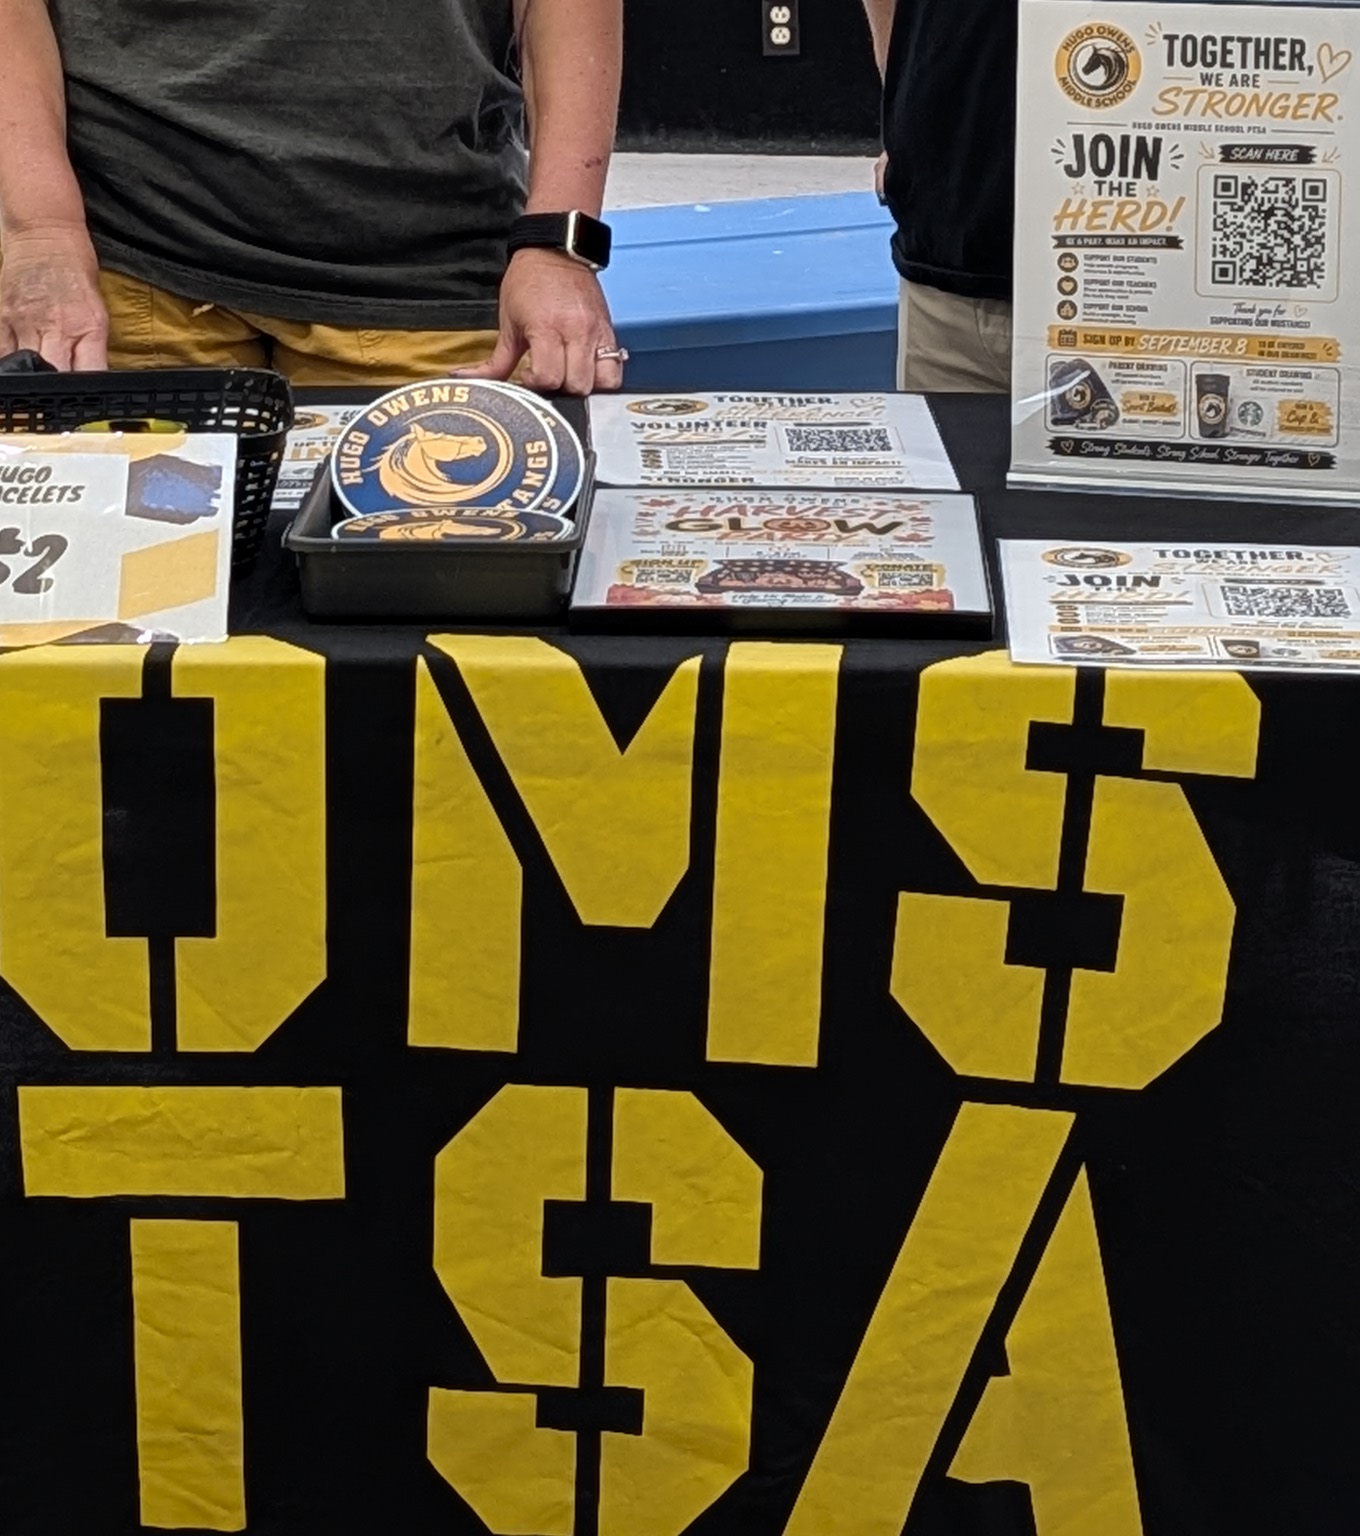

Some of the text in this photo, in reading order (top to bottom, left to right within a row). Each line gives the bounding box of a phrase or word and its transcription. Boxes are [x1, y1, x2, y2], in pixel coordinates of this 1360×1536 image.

[1062, 25, 1135, 54] HUGO OWENS
[1162, 33, 1314, 76] TOGETHER,
[1059, 76, 1137, 107] MIDDLE SCHOOL
[1200, 72, 1261, 88] WE ARE
[1152, 86, 1344, 122] STRONGER.
[1064, 133, 1163, 181] JOIN
[1230, 147, 1298, 161] SCAN HERE
[1094, 180, 1137, 197] THE
[1053, 196, 1186, 233] HERD!
[1083, 334, 1106, 346] SIGN
[1124, 336, 1135, 346] BY
[1138, 334, 1232, 354] SEPTEMBER
[1236, 338, 1248, 354] 8
[340, 430, 371, 485] HUGO
[367, 386, 471, 428] OWENS
[495, 440, 548, 512] TANGS
[1056, 574, 1161, 587] JOIN
